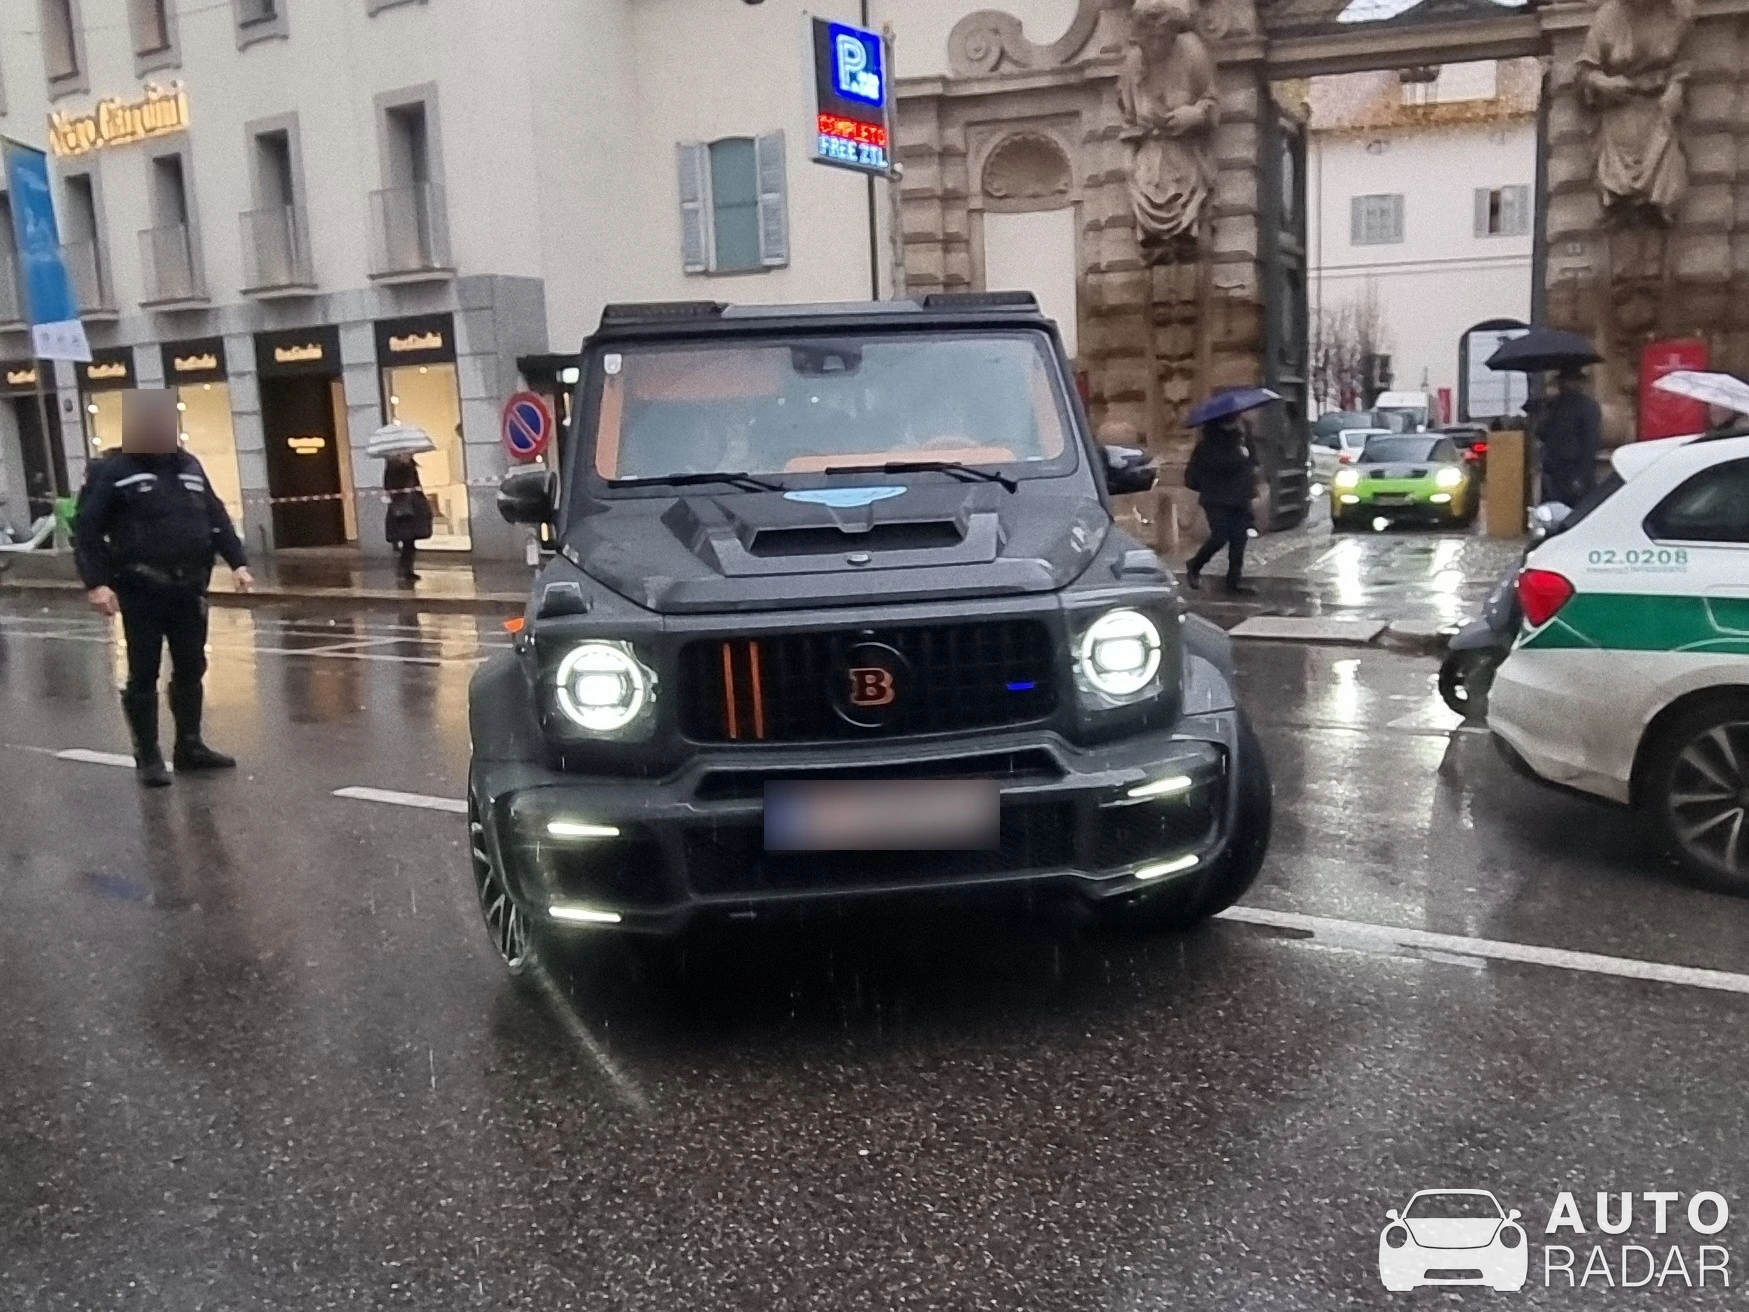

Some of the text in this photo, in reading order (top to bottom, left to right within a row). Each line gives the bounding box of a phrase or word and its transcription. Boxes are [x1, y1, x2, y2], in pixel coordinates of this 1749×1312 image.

[836, 34, 867, 91] P
[818, 114, 887, 147] COMPLETO
[819, 135, 858, 162] FREE
[1588, 549, 1688, 565] 02.0208
[849, 667, 895, 706] B
